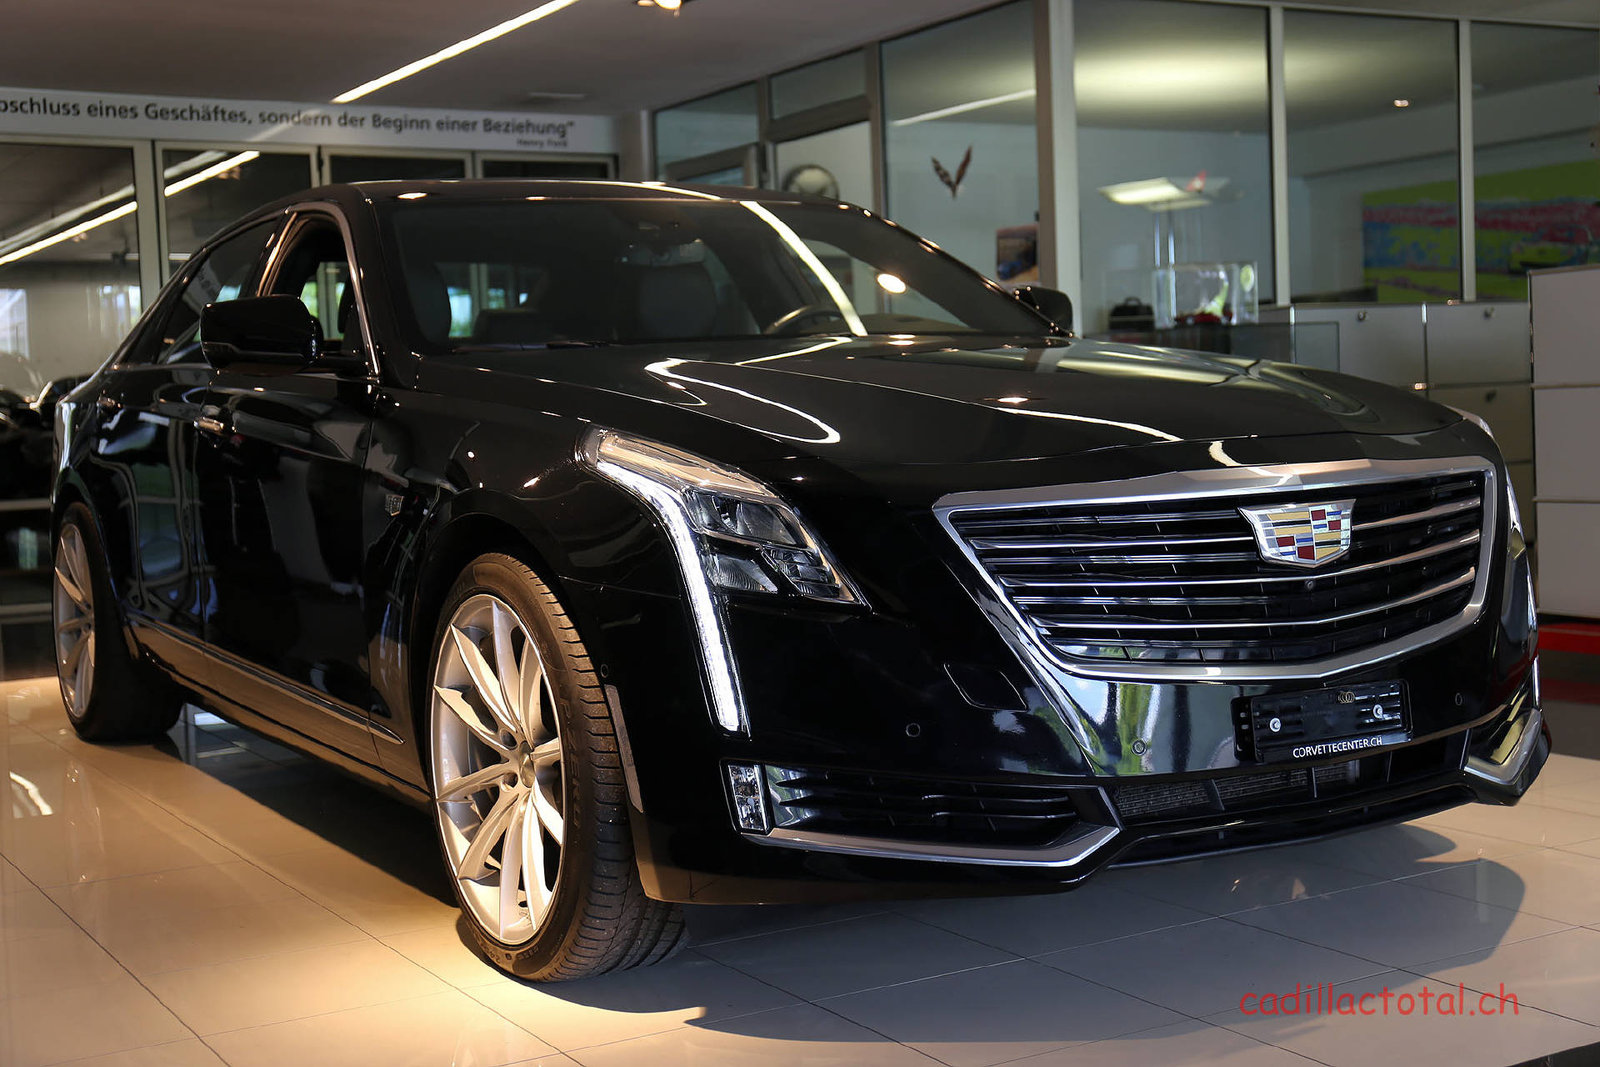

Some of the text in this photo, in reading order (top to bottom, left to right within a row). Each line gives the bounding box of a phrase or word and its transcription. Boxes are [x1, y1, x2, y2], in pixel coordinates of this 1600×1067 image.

[87, 101, 138, 119] eines
[145, 102, 252, 124] Geschäftes,
[258, 109, 331, 127] sondern
[338, 113, 365, 127] der
[372, 114, 430, 133] Beginn
[436, 118, 478, 132] einer
[1293, 737, 1382, 758] CORVETTECENTER.CH
